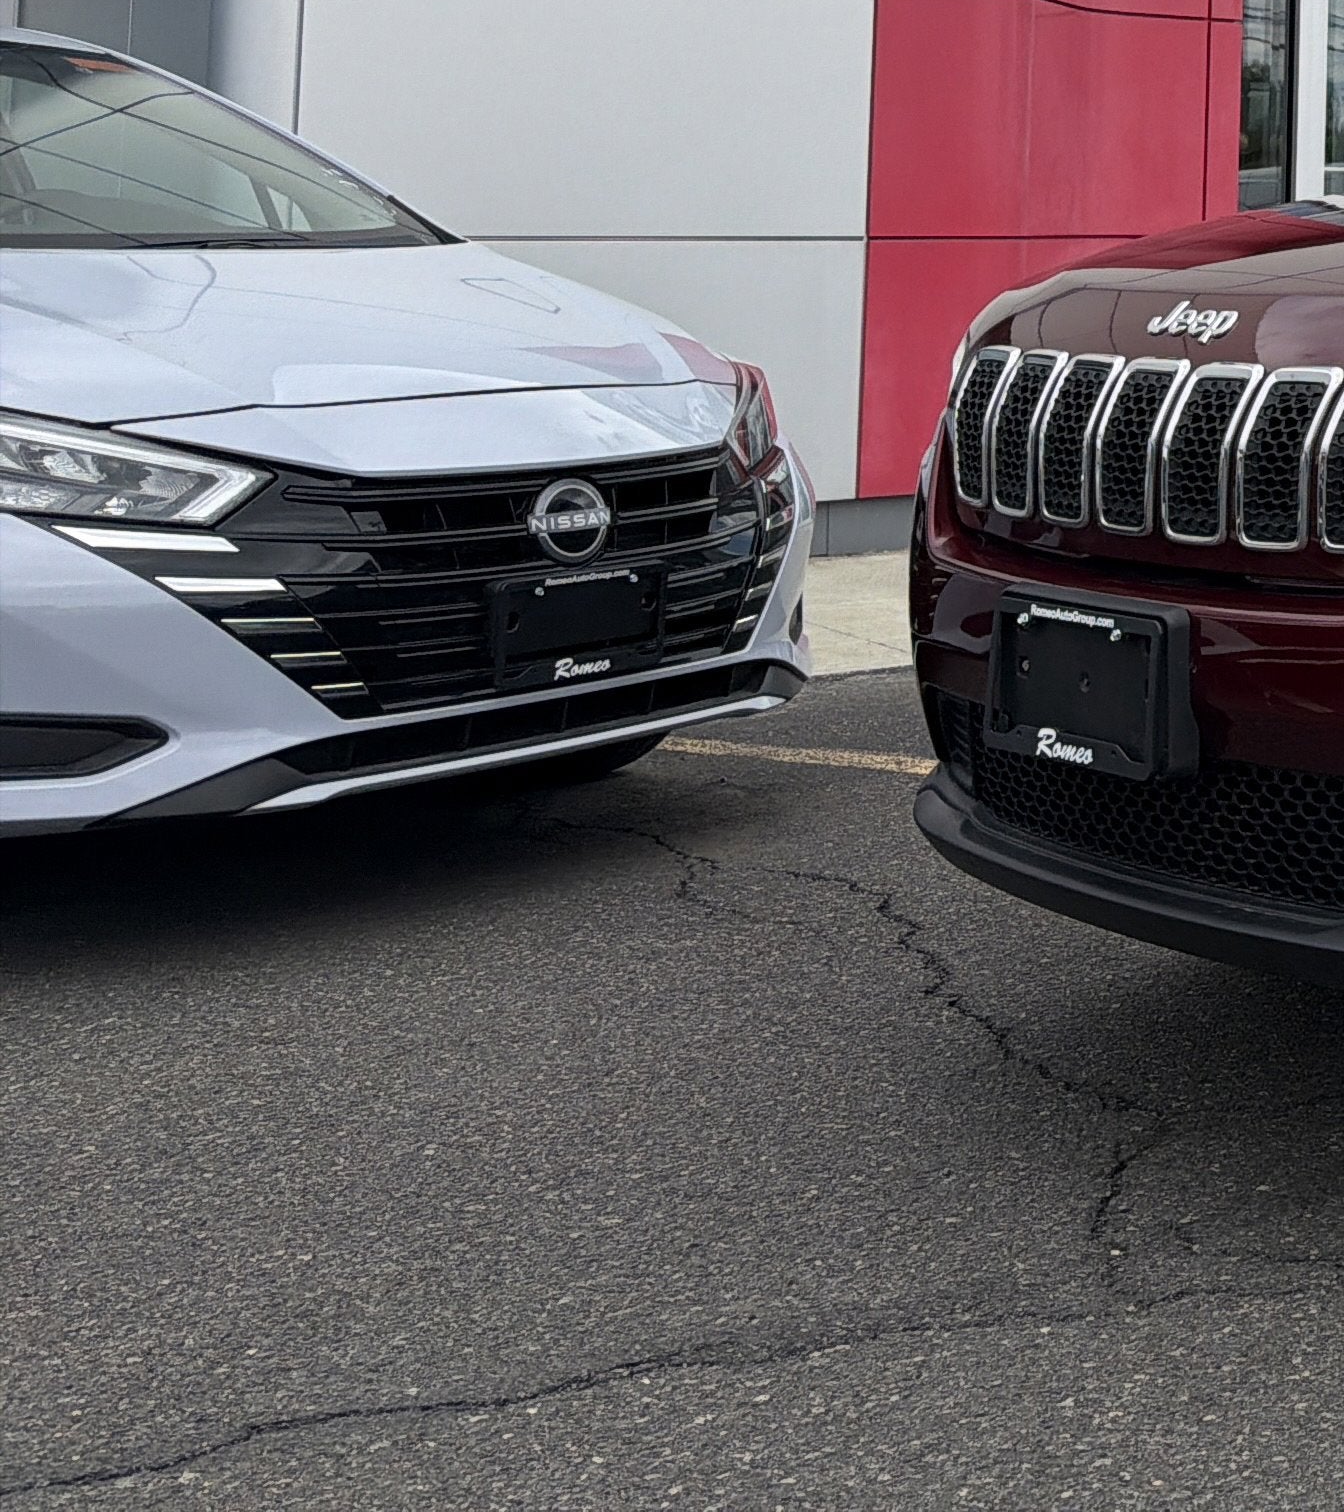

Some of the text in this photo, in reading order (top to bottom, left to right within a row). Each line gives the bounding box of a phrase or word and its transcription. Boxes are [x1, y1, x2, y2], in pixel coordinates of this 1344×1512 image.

[1146, 300, 1239, 344] Jeep
[531, 511, 609, 532] NISSAN
[545, 569, 631, 587] RomeoAutoGroup.com
[1030, 604, 1115, 628] RomeoAutoGroup.com
[554, 657, 611, 681] Romeo
[1035, 727, 1094, 765] Romeo
